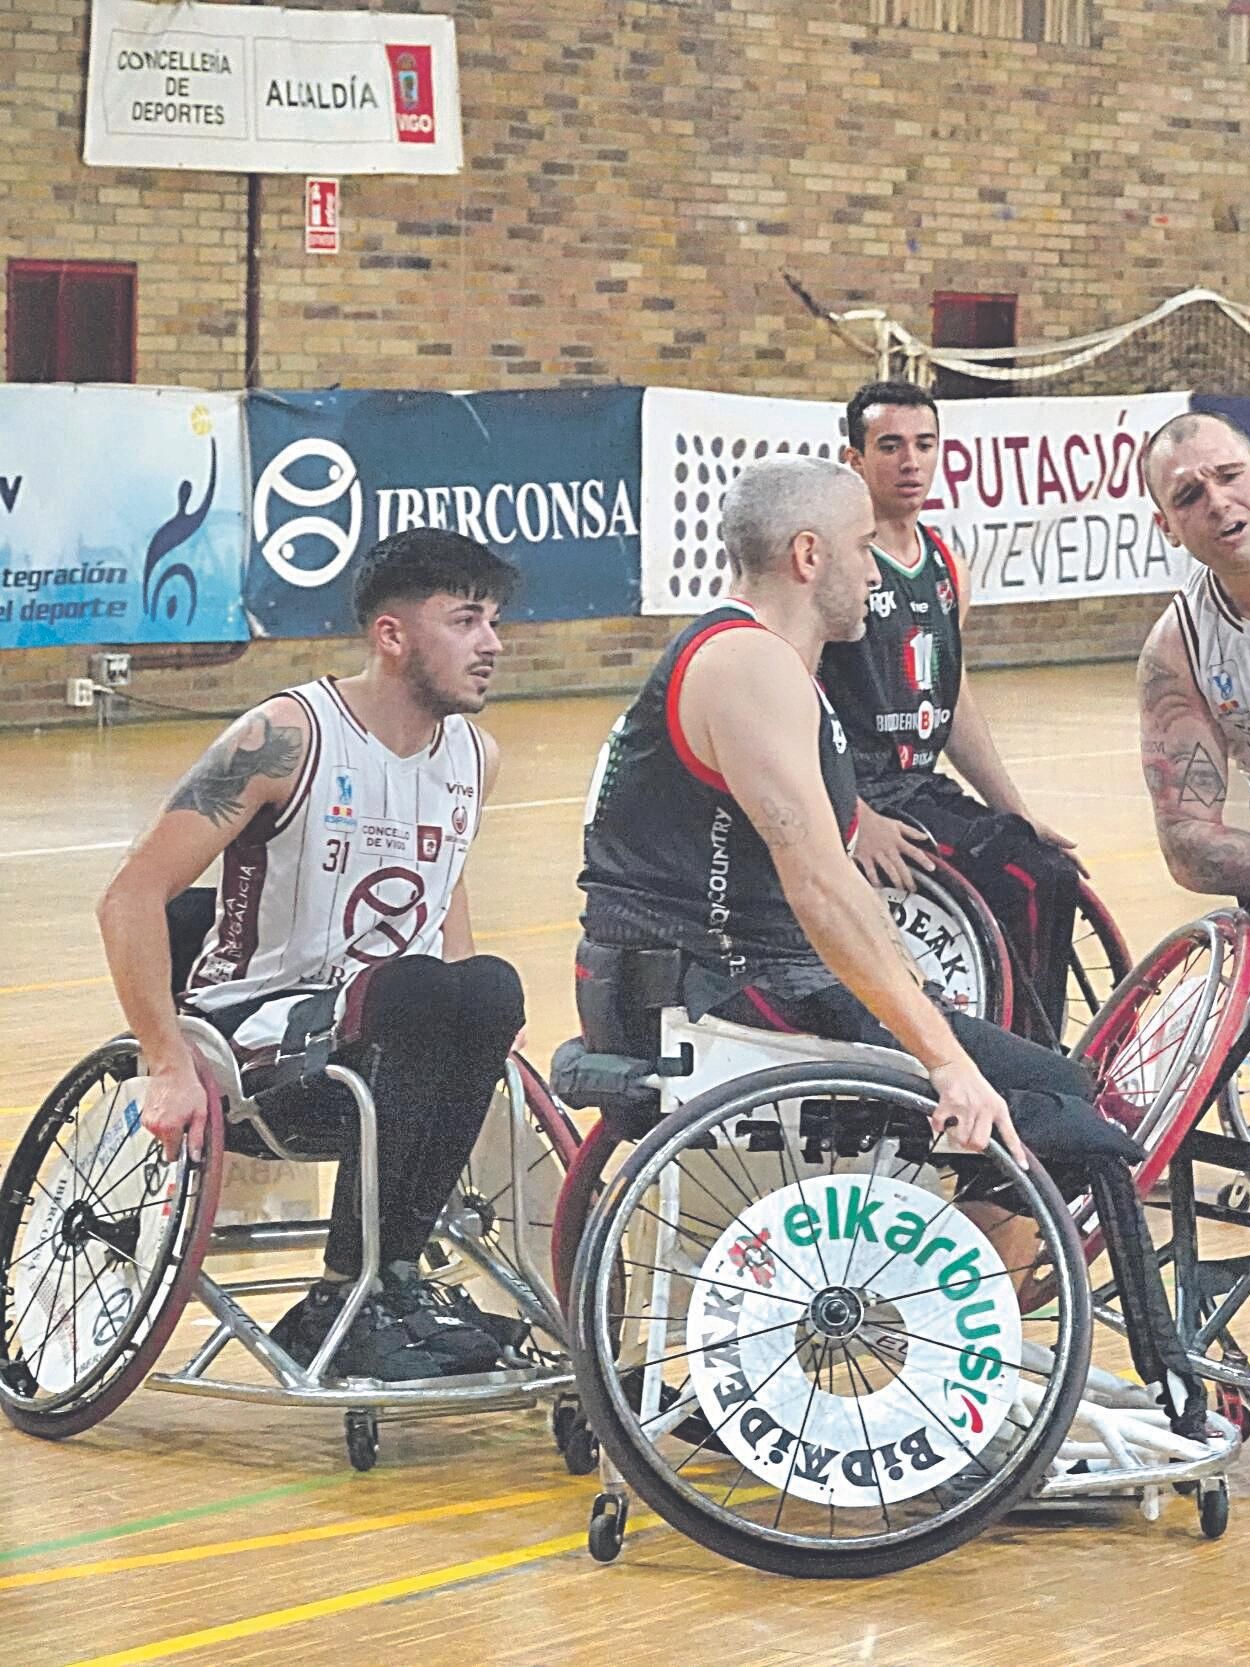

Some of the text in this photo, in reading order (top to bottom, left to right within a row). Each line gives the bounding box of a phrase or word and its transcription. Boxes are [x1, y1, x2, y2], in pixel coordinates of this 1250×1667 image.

[165, 77, 190, 97] DE
[131, 102, 225, 125] DEPORTES
[20, 599, 128, 625] deporte
[366, 837, 382, 848] DE
[322, 838, 351, 874] 31
[229, 865, 257, 936] GALICIA
